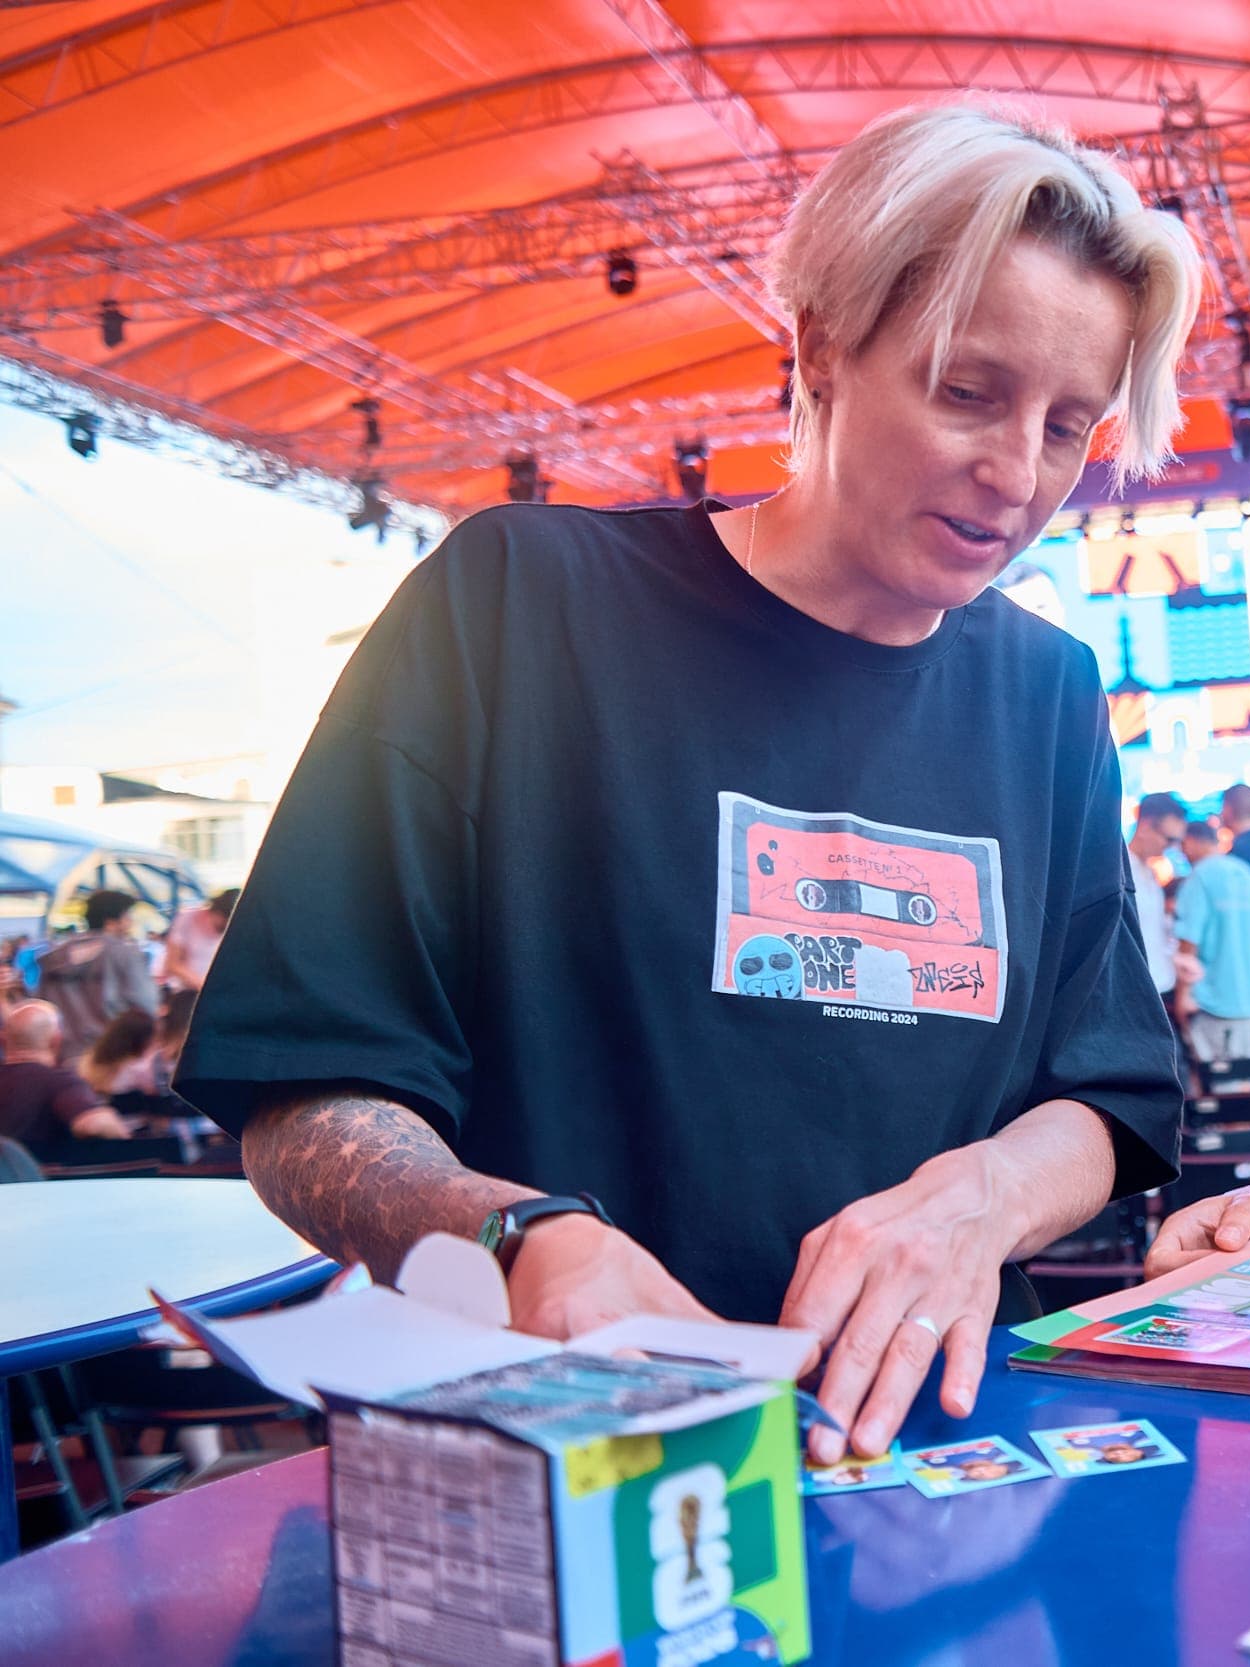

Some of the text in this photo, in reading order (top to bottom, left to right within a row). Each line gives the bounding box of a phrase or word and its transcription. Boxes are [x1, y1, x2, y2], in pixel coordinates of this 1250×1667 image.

[784, 932, 863, 964] PART
[803, 962, 857, 991] ONE
[822, 1005, 918, 1025] RECORDING 2024
